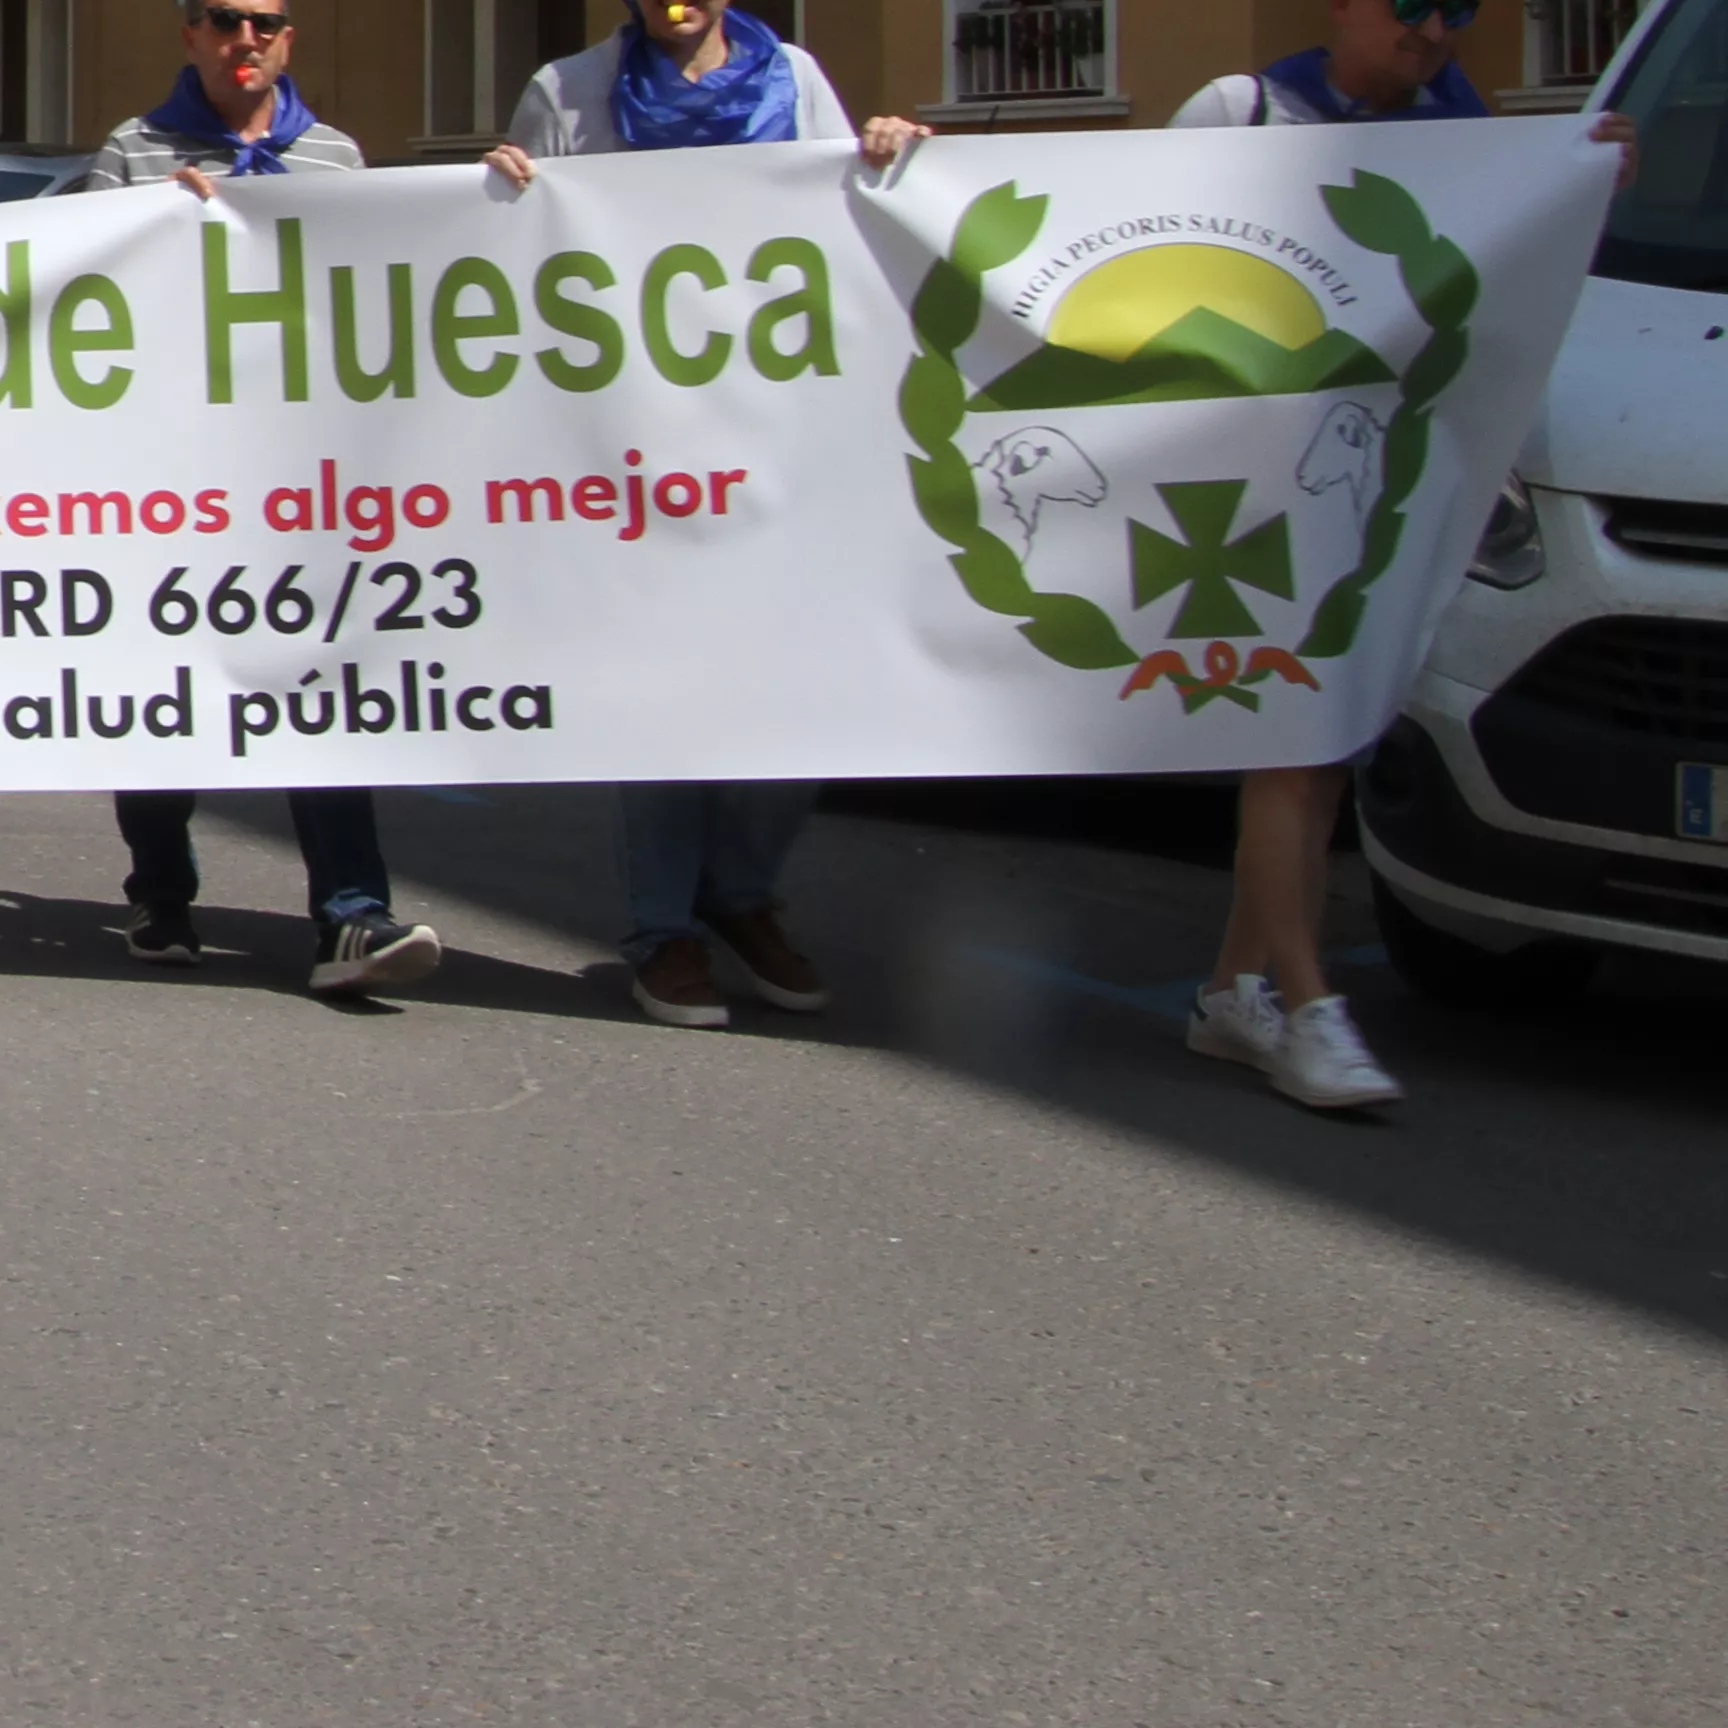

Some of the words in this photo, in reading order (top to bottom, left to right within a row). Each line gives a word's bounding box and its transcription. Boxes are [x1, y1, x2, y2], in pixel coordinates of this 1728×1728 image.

[200, 217, 842, 405] Huesca
[1011, 259, 1070, 319] HIGIA
[1067, 214, 1182, 260] PECORIS
[1186, 213, 1277, 247] SALUS
[1276, 236, 1357, 307] POPULI
[263, 459, 450, 552] algo
[485, 448, 748, 541] mejor
[0, 570, 114, 638] RD
[148, 558, 483, 643] 666/23
[229, 660, 554, 758] pública
